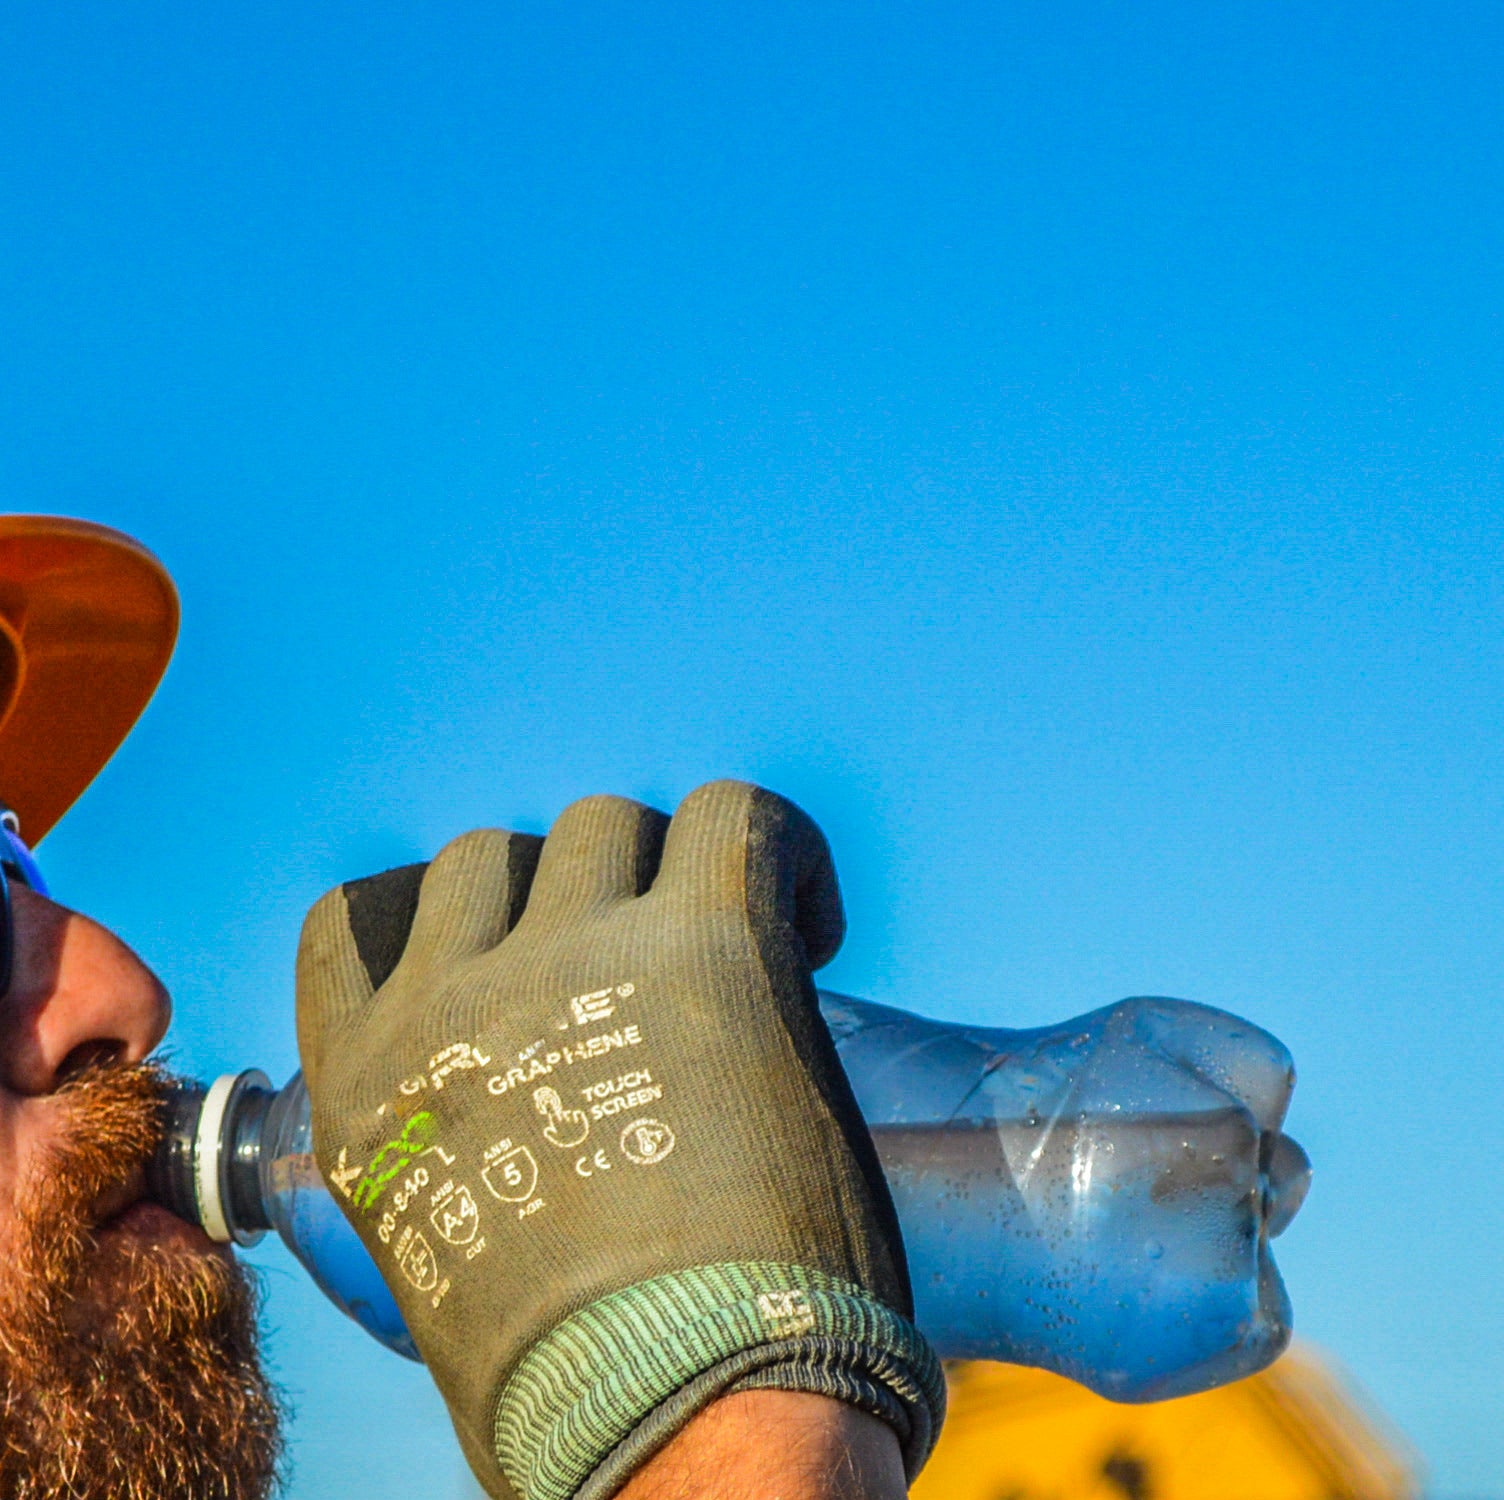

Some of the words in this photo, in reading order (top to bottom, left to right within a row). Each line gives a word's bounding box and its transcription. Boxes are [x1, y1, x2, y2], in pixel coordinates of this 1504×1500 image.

[488, 1025, 642, 1095] GRAPHENE
[582, 1068, 653, 1101] TOUCH
[591, 1084, 663, 1120] SCREEN
[484, 1138, 513, 1163] ANSI
[504, 1162, 522, 1186] 5
[430, 1180, 455, 1207] ANSI
[466, 1236, 487, 1260] CUT
